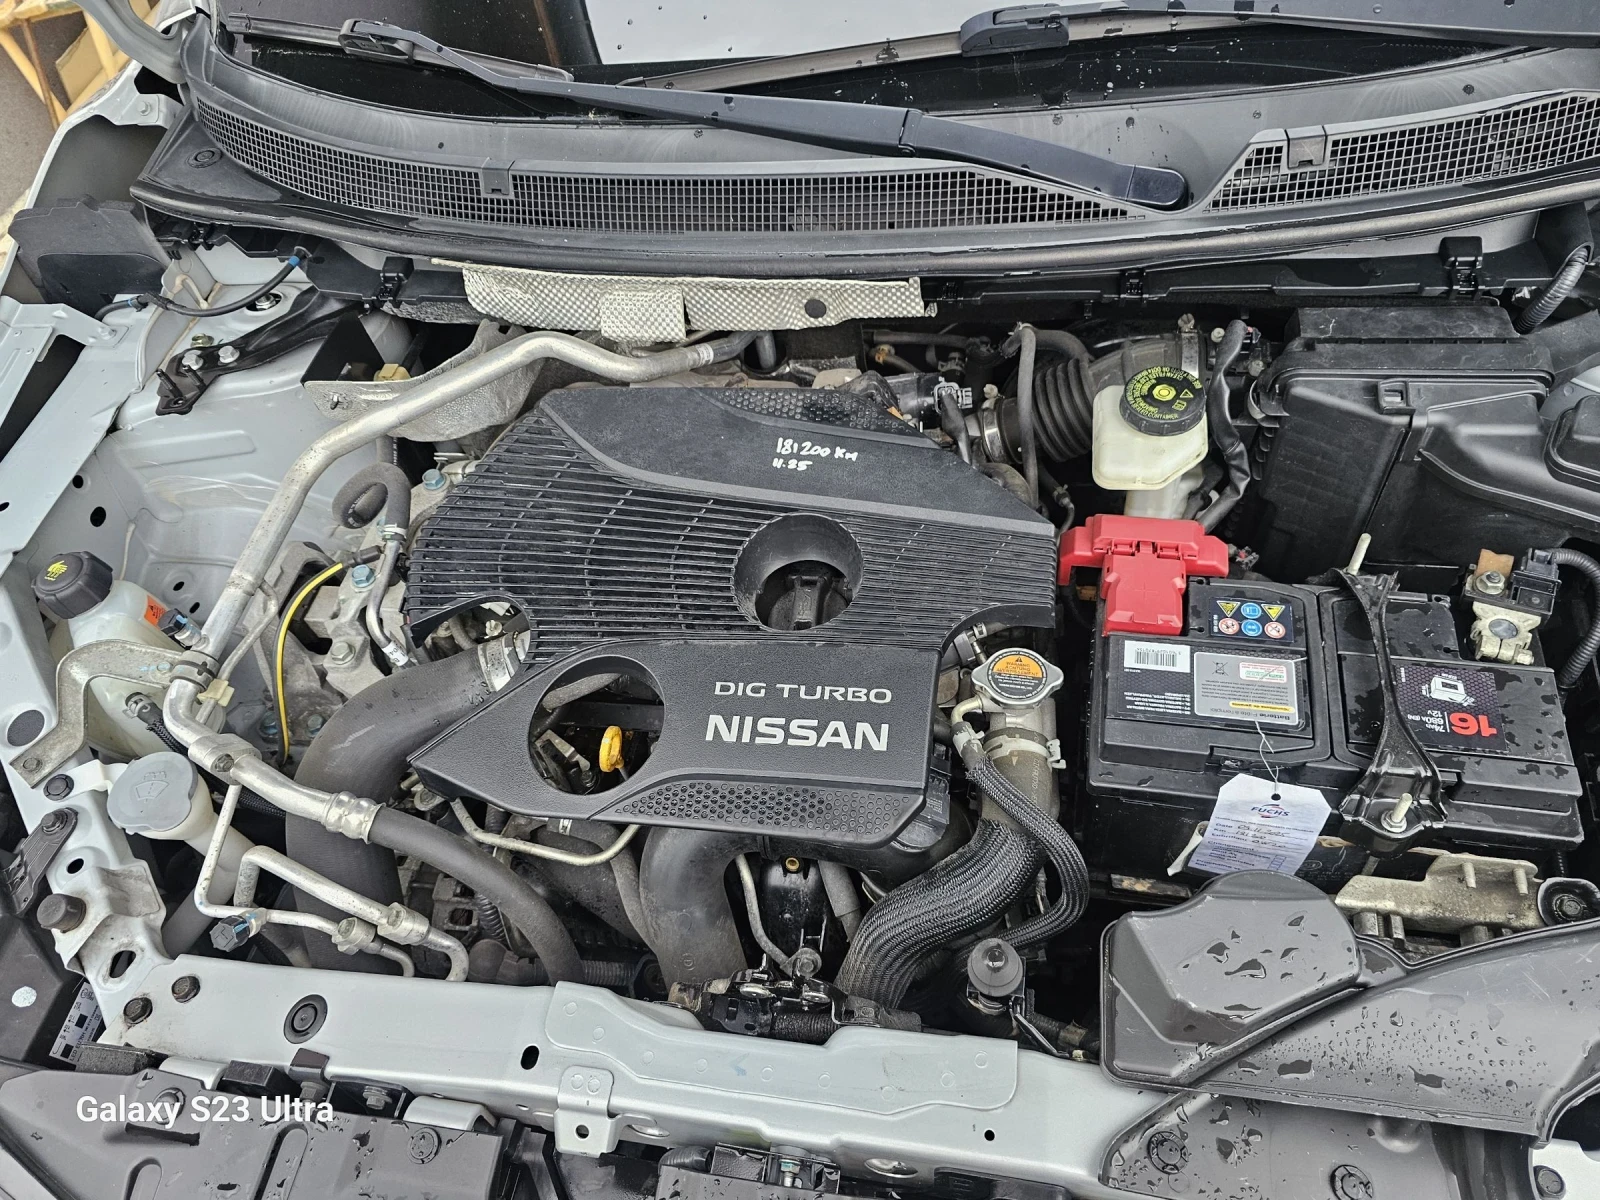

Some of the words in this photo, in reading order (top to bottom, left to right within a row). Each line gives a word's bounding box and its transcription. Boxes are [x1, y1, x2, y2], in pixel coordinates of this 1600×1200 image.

[714, 682, 766, 697] DIG
[776, 684, 892, 703] TURBO
[705, 714, 889, 751] NISSAN
[1450, 712, 1497, 737] 16
[1251, 806, 1290, 816] FUCHS
